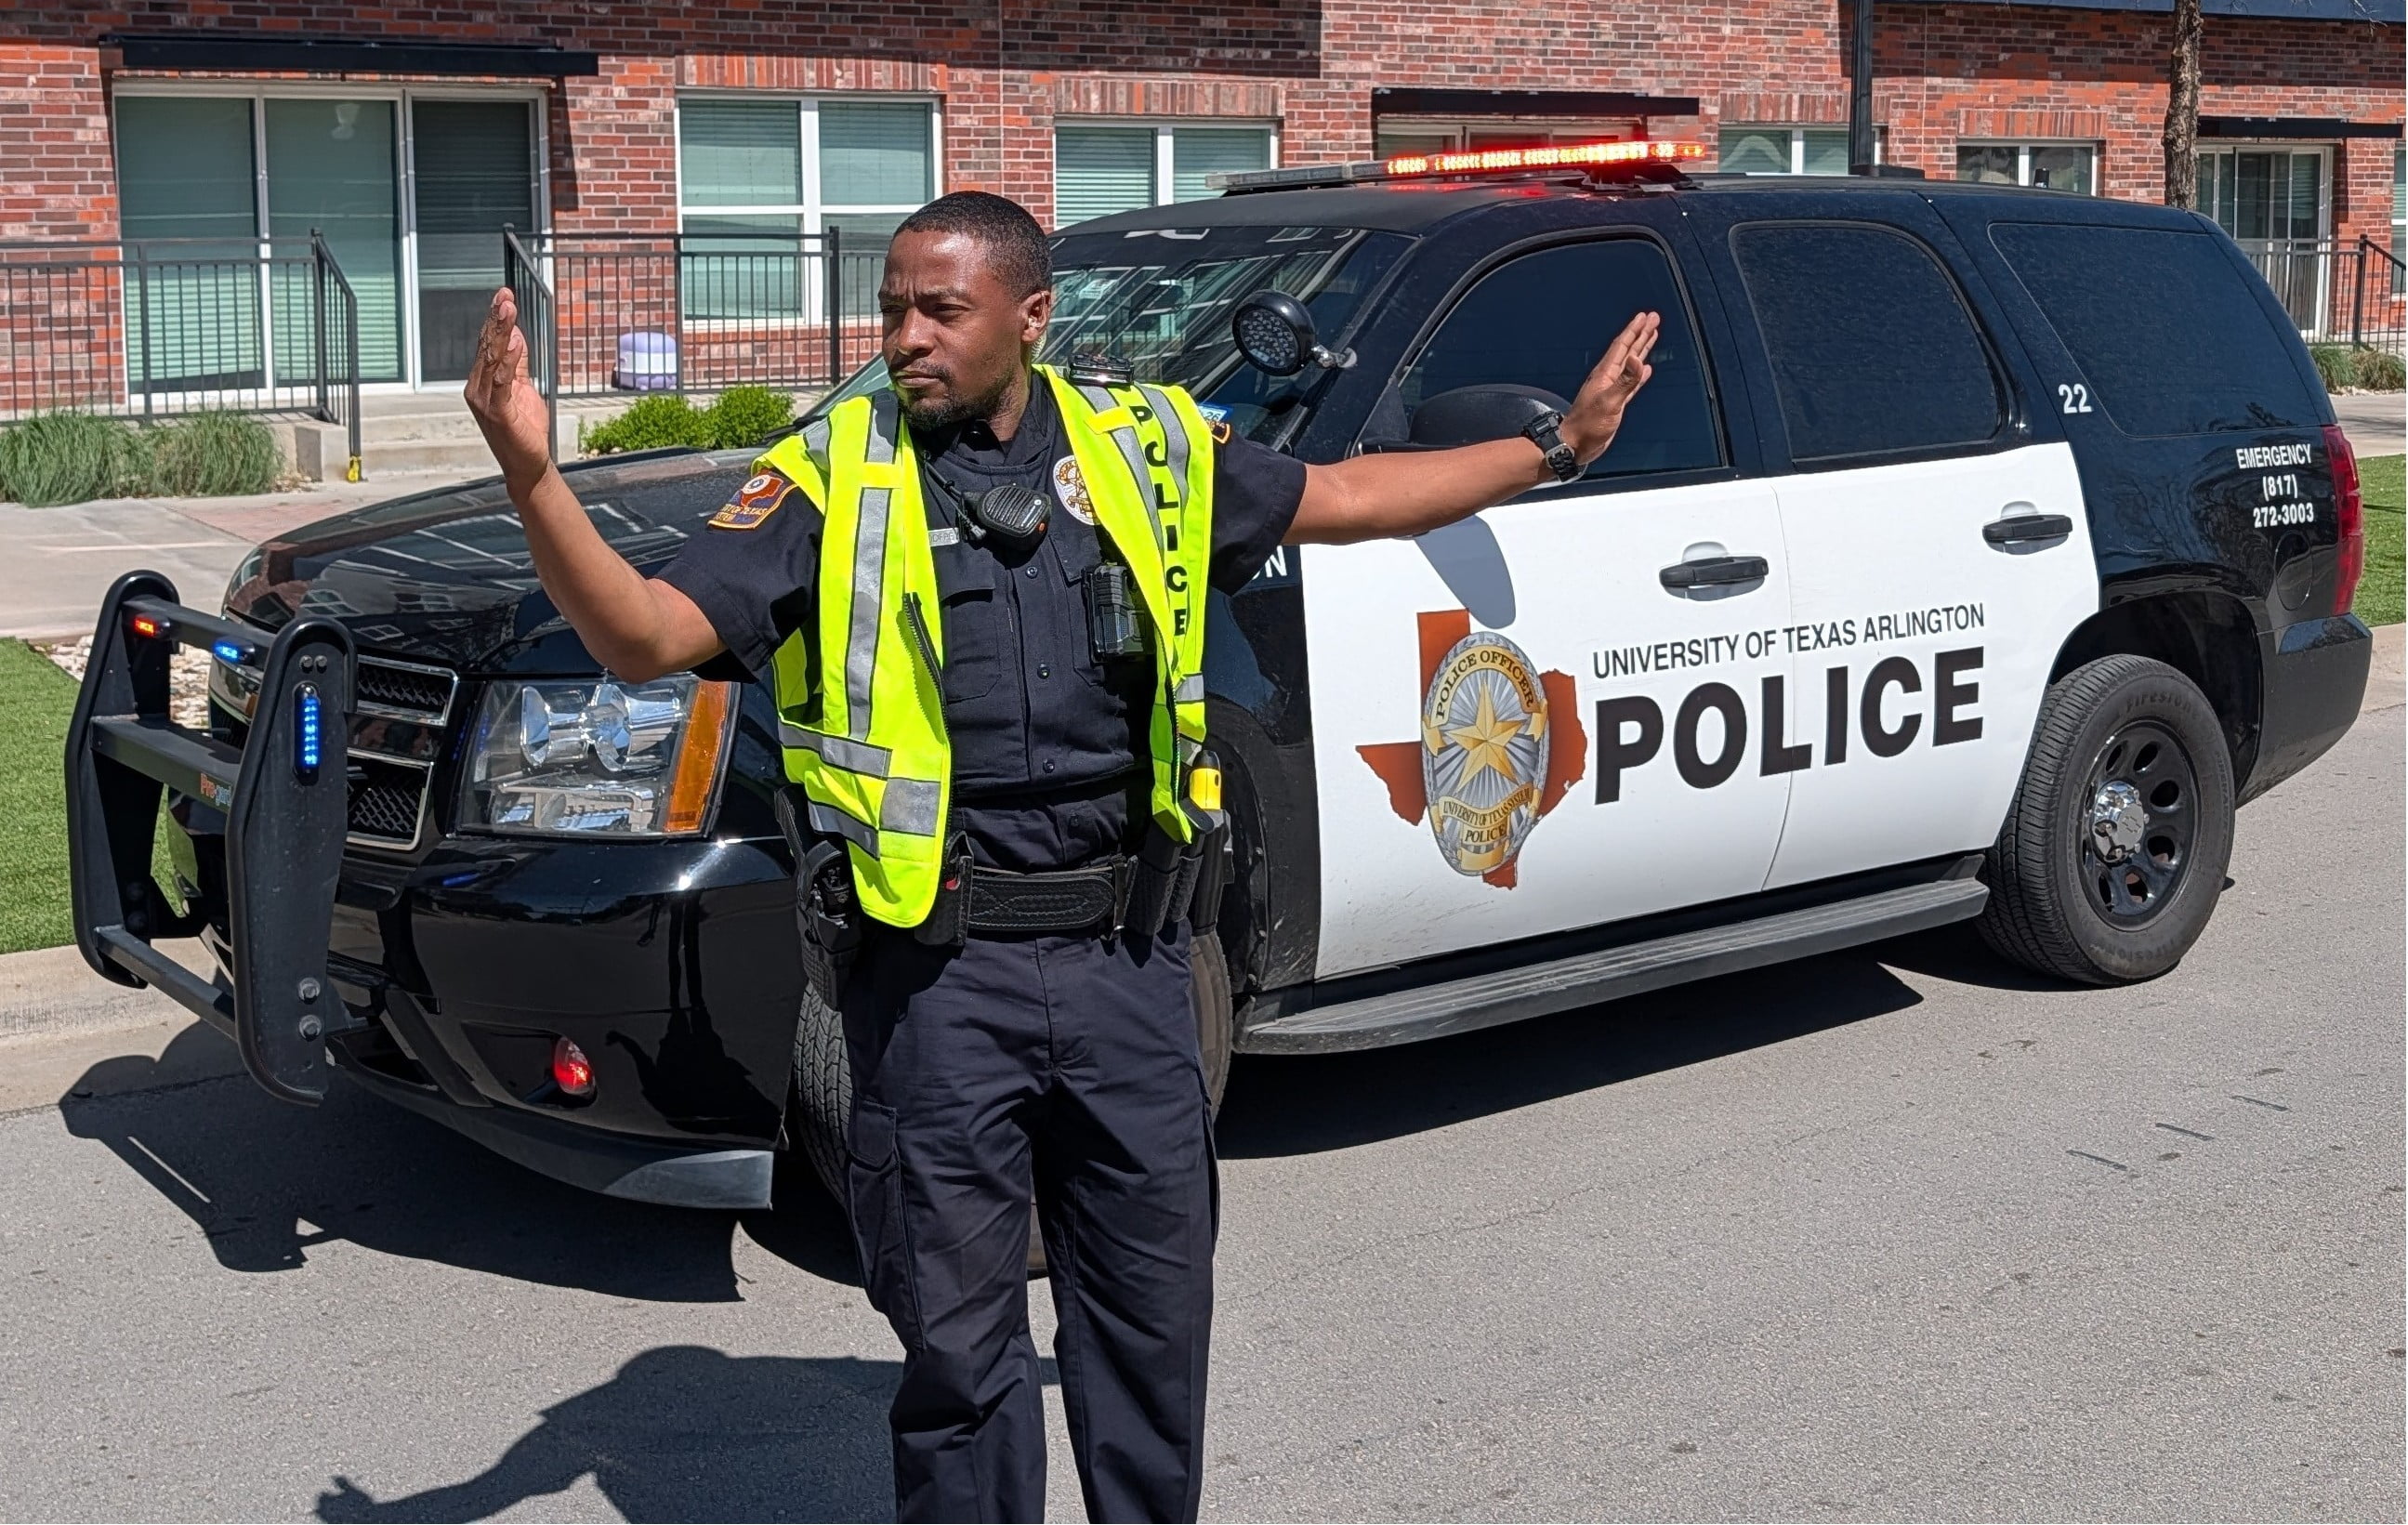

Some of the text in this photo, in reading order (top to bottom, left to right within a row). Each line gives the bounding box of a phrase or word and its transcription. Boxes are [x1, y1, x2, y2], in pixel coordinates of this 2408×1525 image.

[2058, 384, 2092, 414] 22
[2235, 444, 2312, 469] EMERGENCY
[2262, 474, 2298, 502] (817)
[1129, 405, 1188, 637] POLICE
[2253, 502, 2315, 529] 272-3003
[1593, 602, 1985, 679] UNIVERSITY OF TEXAS ARLINGTON
[1434, 650, 1534, 720] POLICE OFFICER
[1594, 646, 1985, 806] POLICE
[1443, 800, 1479, 826] UNIVERSITY
[1465, 824, 1507, 843] POLICE
